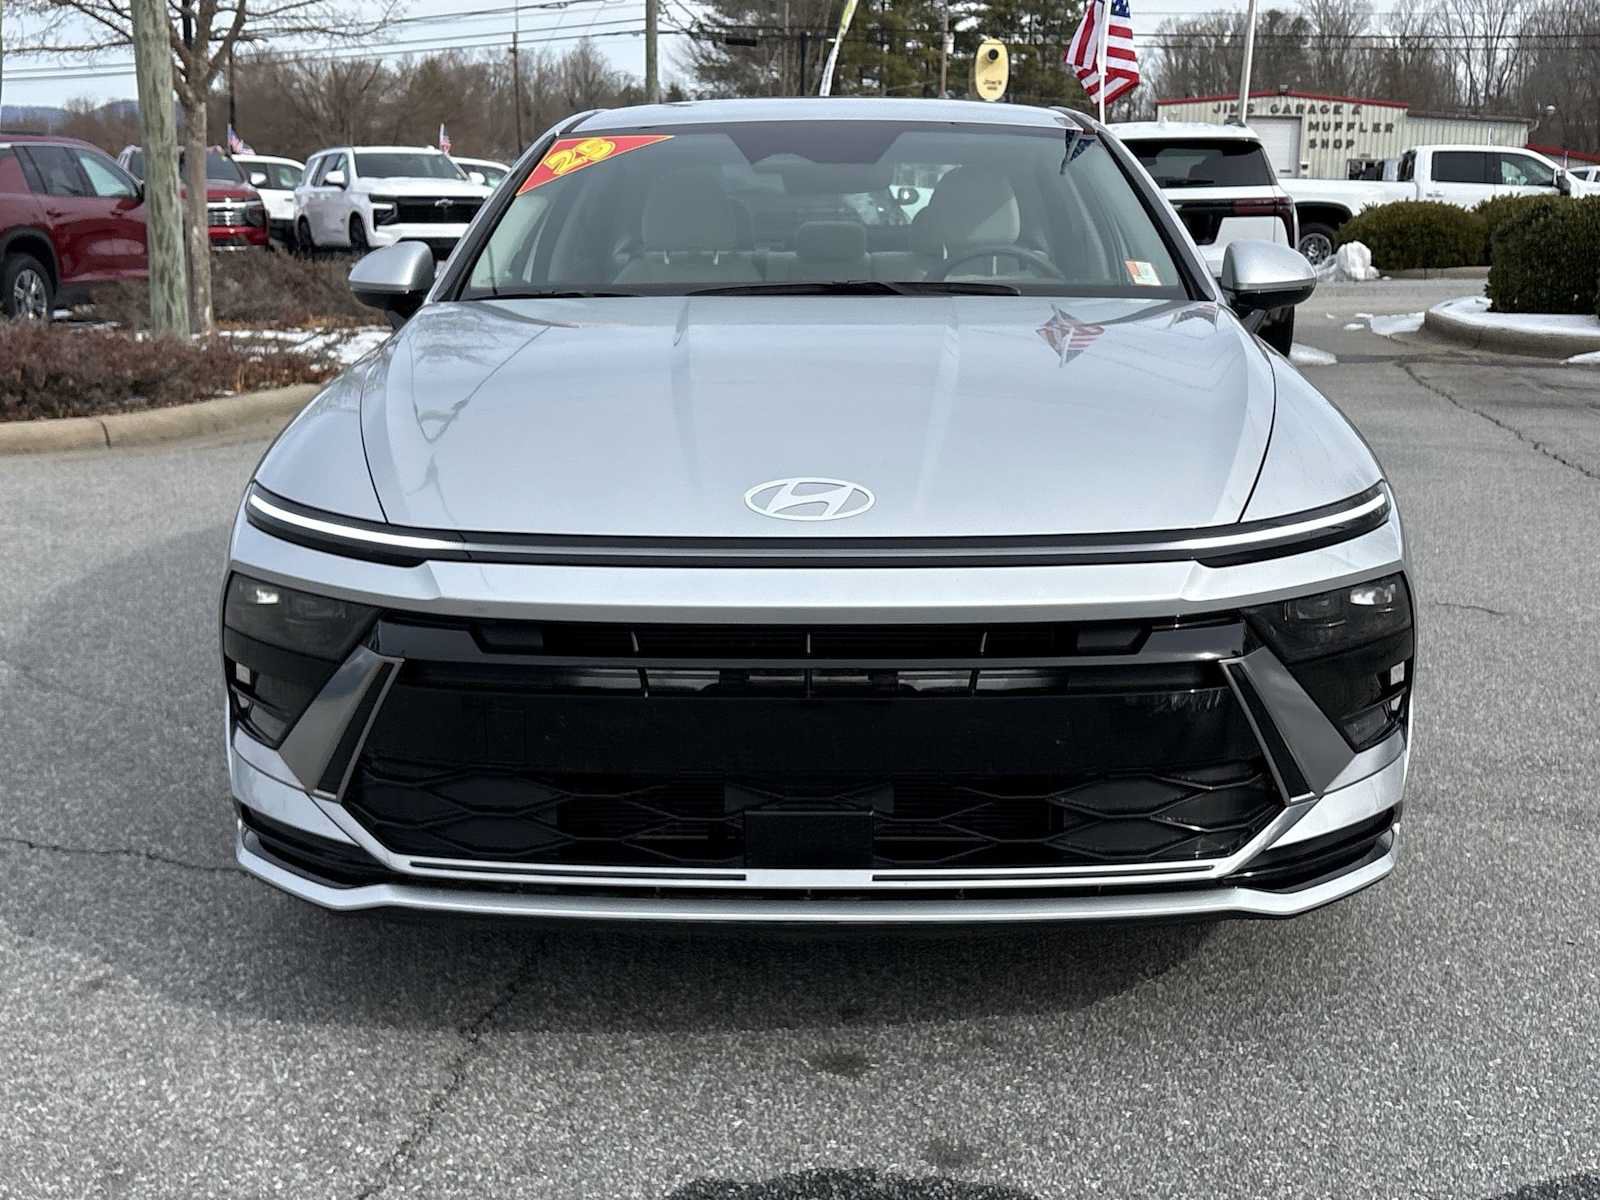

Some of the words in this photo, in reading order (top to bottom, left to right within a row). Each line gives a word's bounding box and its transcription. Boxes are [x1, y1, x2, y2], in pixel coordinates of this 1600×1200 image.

[1270, 103, 1344, 115] GARAGE
[1351, 104, 1362, 115] &
[1307, 121, 1395, 133] MUFFLER
[1308, 138, 1355, 150] SHOP
